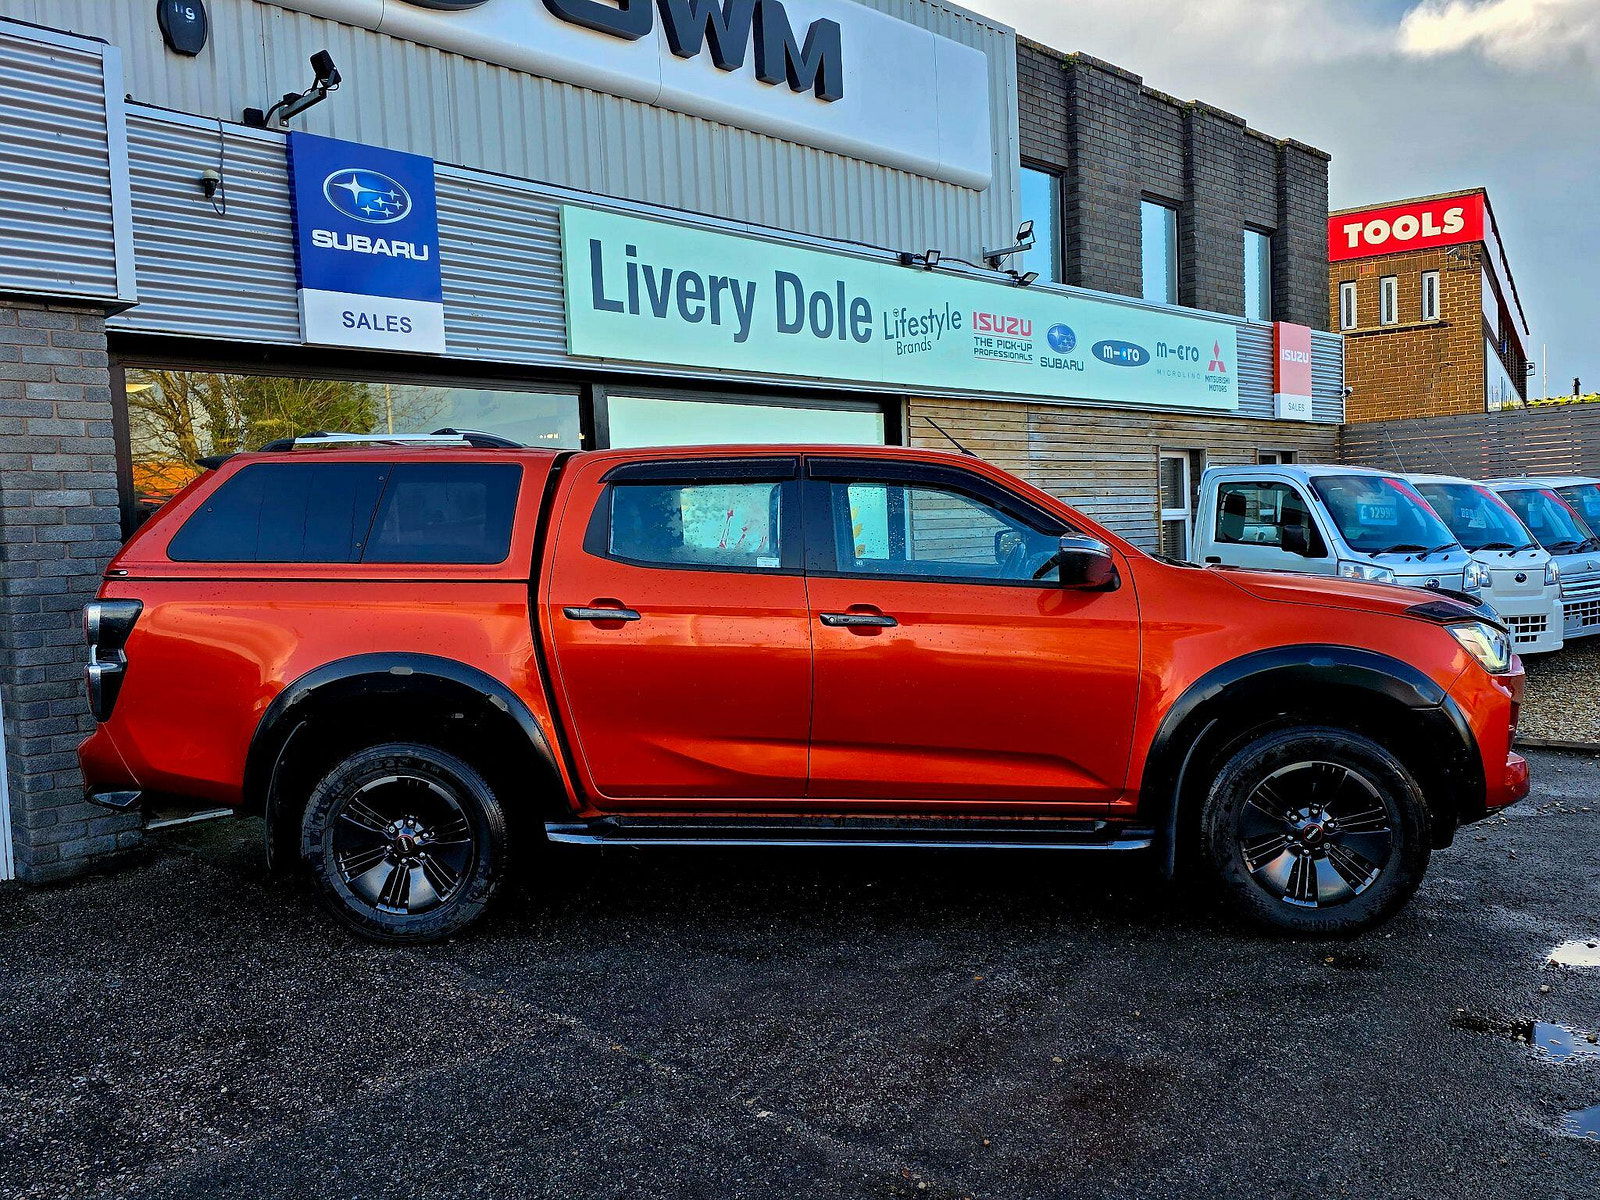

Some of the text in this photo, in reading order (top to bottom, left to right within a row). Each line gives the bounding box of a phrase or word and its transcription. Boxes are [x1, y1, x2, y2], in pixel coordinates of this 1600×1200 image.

[1343, 207, 1465, 248] TOOLS
[311, 228, 429, 261] SUBARU
[589, 238, 873, 343] Livery Dole
[342, 310, 413, 334] SALES
[883, 302, 962, 341] Lifestyle
[972, 311, 1032, 336] ISUZU
[896, 336, 932, 356] Brands
[973, 336, 1033, 352] THE PICK-UP
[973, 347, 1033, 361] PROFESSIONALS
[1281, 348, 1309, 363] ISUZU
[1040, 356, 1085, 372] SUBARU
[1156, 369, 1201, 380] MICROLINO
[1204, 374, 1231, 385] MITSUBISHI
[1208, 383, 1228, 393] MOTORS
[1287, 402, 1305, 412] SALES
